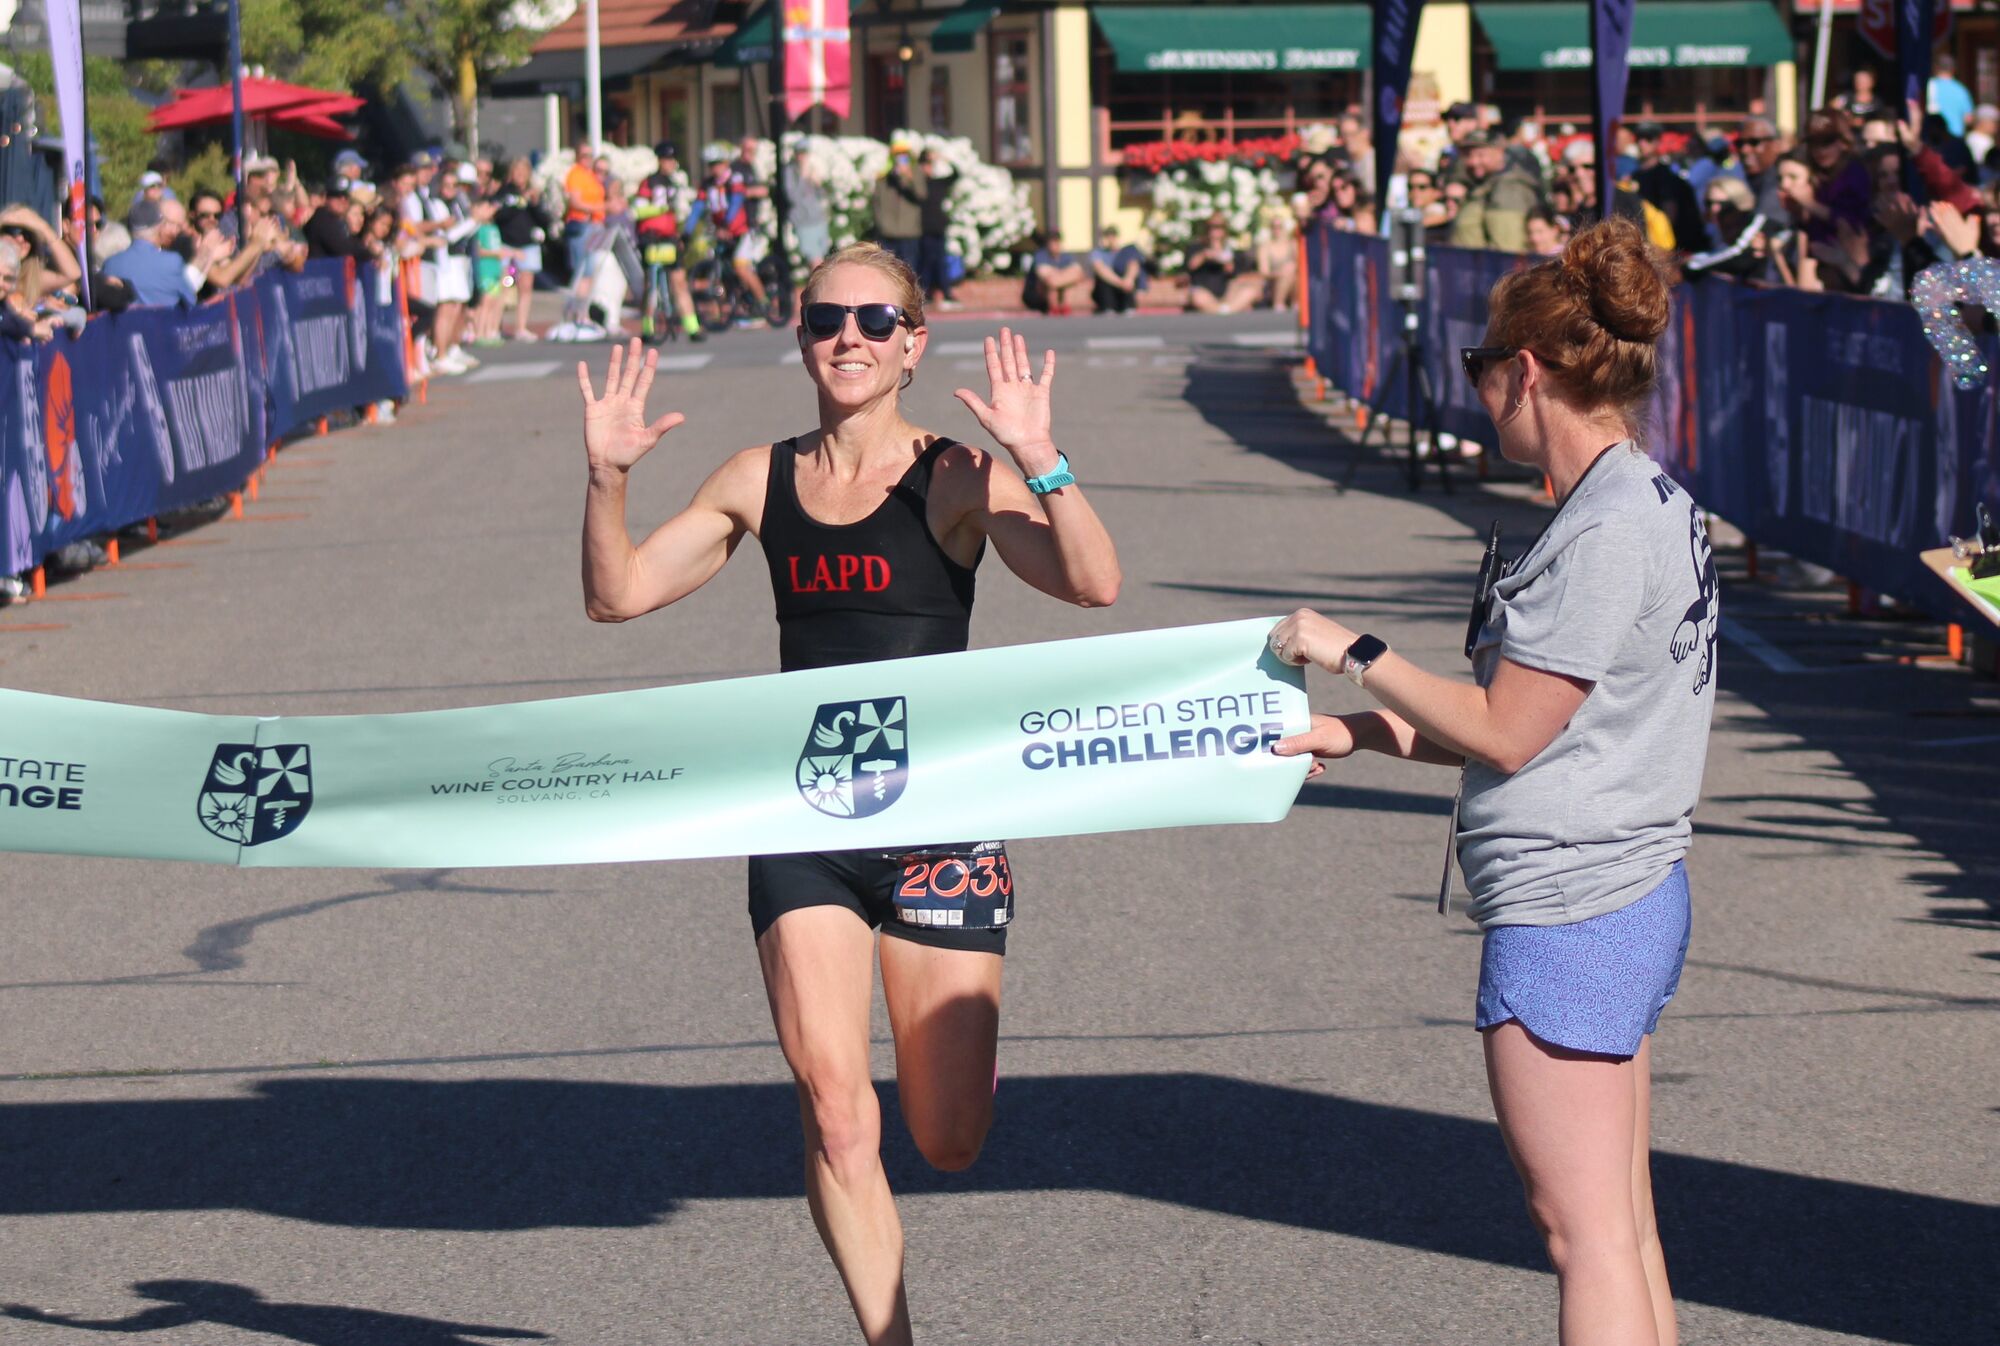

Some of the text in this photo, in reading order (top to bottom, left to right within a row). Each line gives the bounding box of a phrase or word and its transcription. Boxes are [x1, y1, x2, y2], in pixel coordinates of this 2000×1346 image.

[787, 554, 892, 592] LAPD
[1019, 690, 1283, 735] GOLDEN STATE
[1021, 722, 1284, 771] CHALLENGE
[0, 756, 87, 783] TATE
[431, 767, 685, 795] WINE COUNTRY HALF
[487, 752, 633, 777] Santa Barbara
[497, 788, 612, 804] SOLVANG, CA
[899, 855, 1012, 897] 2033
